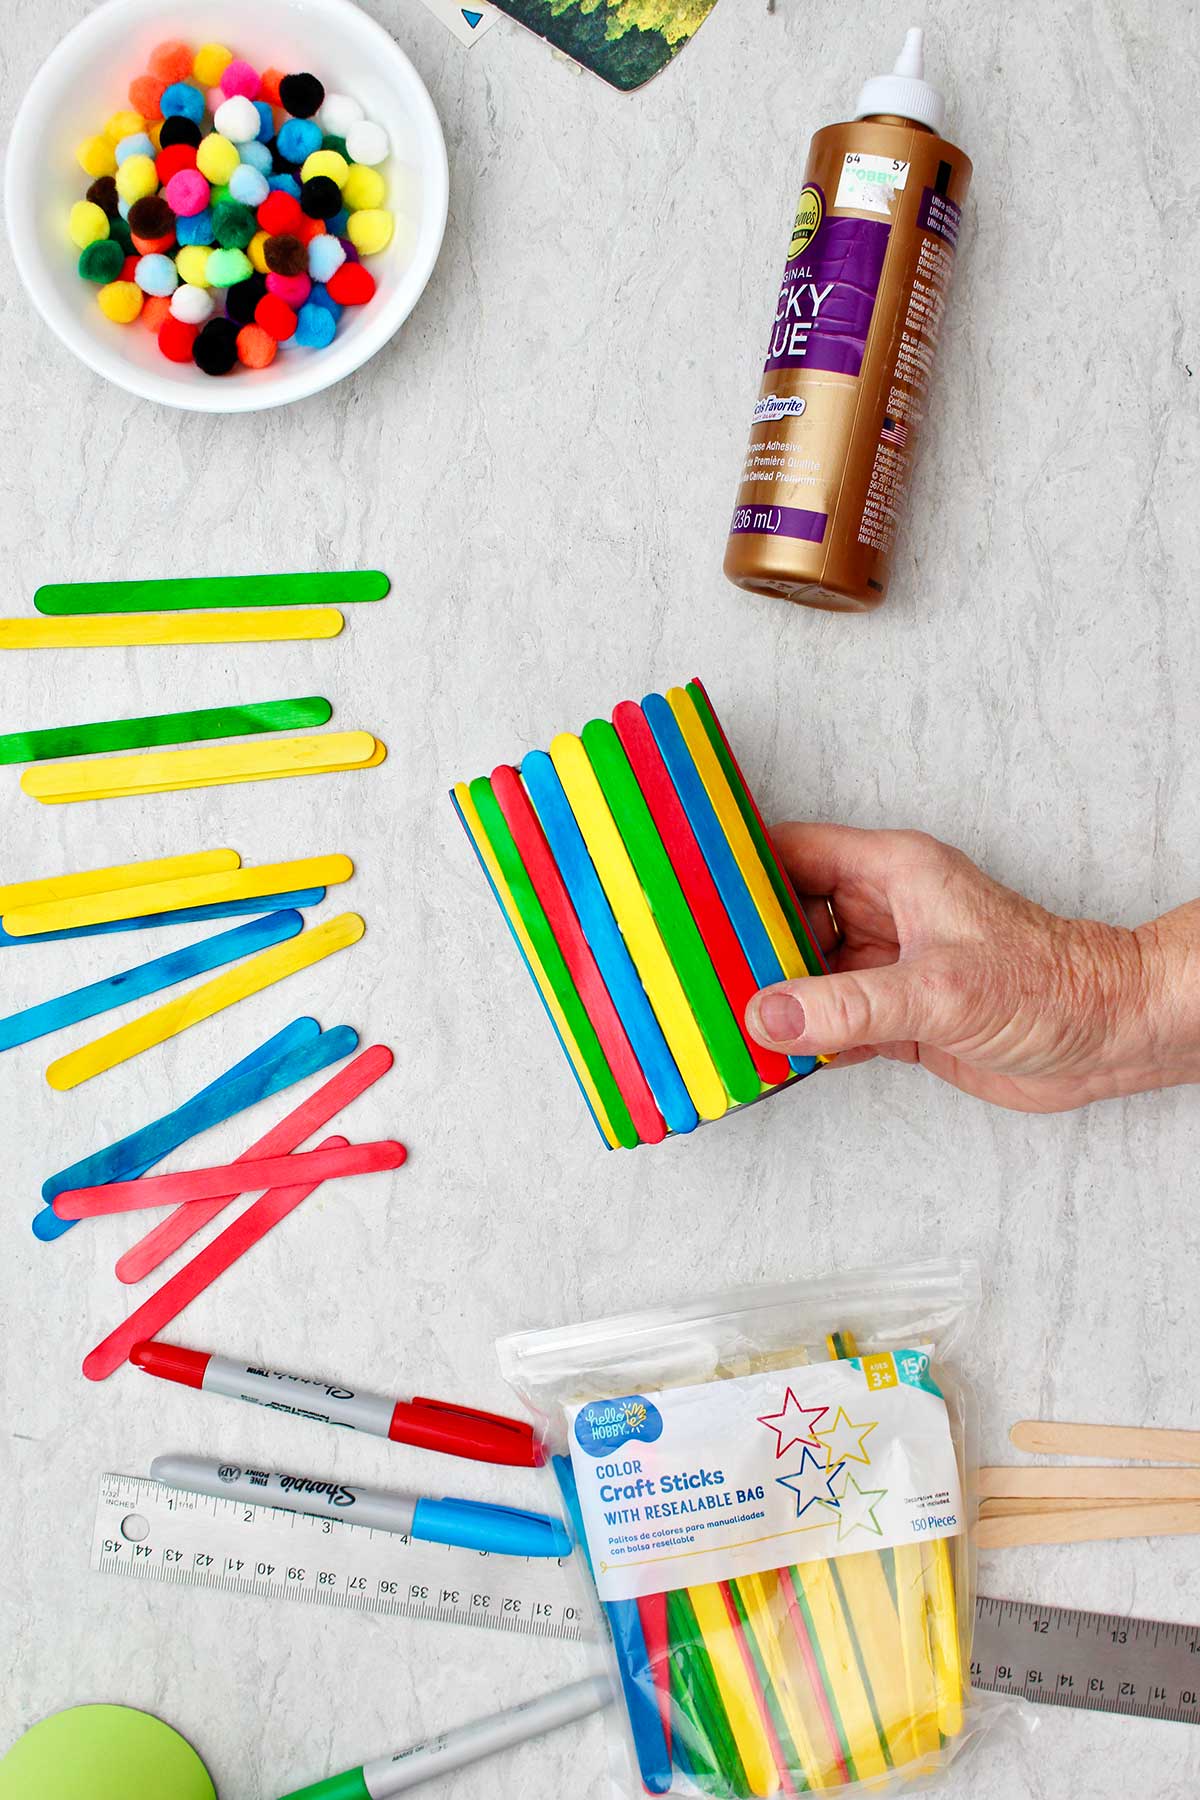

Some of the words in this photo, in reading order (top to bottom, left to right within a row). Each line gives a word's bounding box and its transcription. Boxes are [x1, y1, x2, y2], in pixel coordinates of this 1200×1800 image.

[846, 153, 860, 164] 64
[765, 398, 803, 415] Favorite
[753, 508, 781, 533] mL)
[900, 1355, 928, 1376] 150
[871, 1372, 892, 1388] 3+
[585, 1408, 625, 1428] hello
[592, 1422, 626, 1440] HOBBY
[244, 1469, 270, 1478] POINT
[596, 1460, 642, 1480] COLOR
[250, 1476, 268, 1487] FINE
[279, 1474, 366, 1507] Sharpie
[600, 1478, 656, 1503] Craft
[659, 1468, 725, 1494] Sticks
[102, 1490, 117, 1498] 1/32
[106, 1498, 136, 1509] INCHES
[604, 1509, 641, 1526] WITH
[645, 1492, 733, 1520] RESEALABLE
[736, 1486, 765, 1504] BAG
[168, 1499, 174, 1510] 1
[179, 1502, 194, 1510] 1/16
[244, 1510, 253, 1522] 2
[322, 1522, 330, 1534] 3
[400, 1534, 408, 1546] 4
[608, 1534, 638, 1545] Palitos
[640, 1530, 651, 1540] de
[652, 1526, 684, 1539] colores
[686, 1523, 705, 1536] para
[706, 1510, 766, 1530] manualidades
[911, 1518, 927, 1532] 150
[928, 1514, 957, 1528] Pieces
[610, 1546, 626, 1556] con
[627, 1542, 651, 1554] bolsa
[652, 1534, 696, 1550] resellable
[104, 1539, 122, 1552] 45
[135, 1544, 152, 1558] 44
[166, 1548, 184, 1562] 43
[196, 1554, 214, 1566] 42
[228, 1558, 245, 1572] 41
[257, 1562, 275, 1576] 40
[288, 1568, 306, 1580] 39
[319, 1572, 336, 1585] 38
[350, 1576, 368, 1590] 37
[380, 1580, 398, 1594] 36
[412, 1585, 430, 1599] 35
[443, 1590, 460, 1603] 34
[473, 1594, 491, 1608] 33
[504, 1598, 522, 1612] 32
[536, 1603, 553, 1617] 31
[1032, 1620, 1050, 1634] 12
[1110, 1630, 1127, 1644] 13
[998, 1666, 1012, 1679] 16
[1028, 1670, 1044, 1684] 15
[1060, 1674, 1074, 1688] 14
[1090, 1678, 1104, 1692] 13
[1120, 1682, 1136, 1696] 12
[1154, 1686, 1167, 1700] 11
[1182, 1690, 1198, 1704] 10
